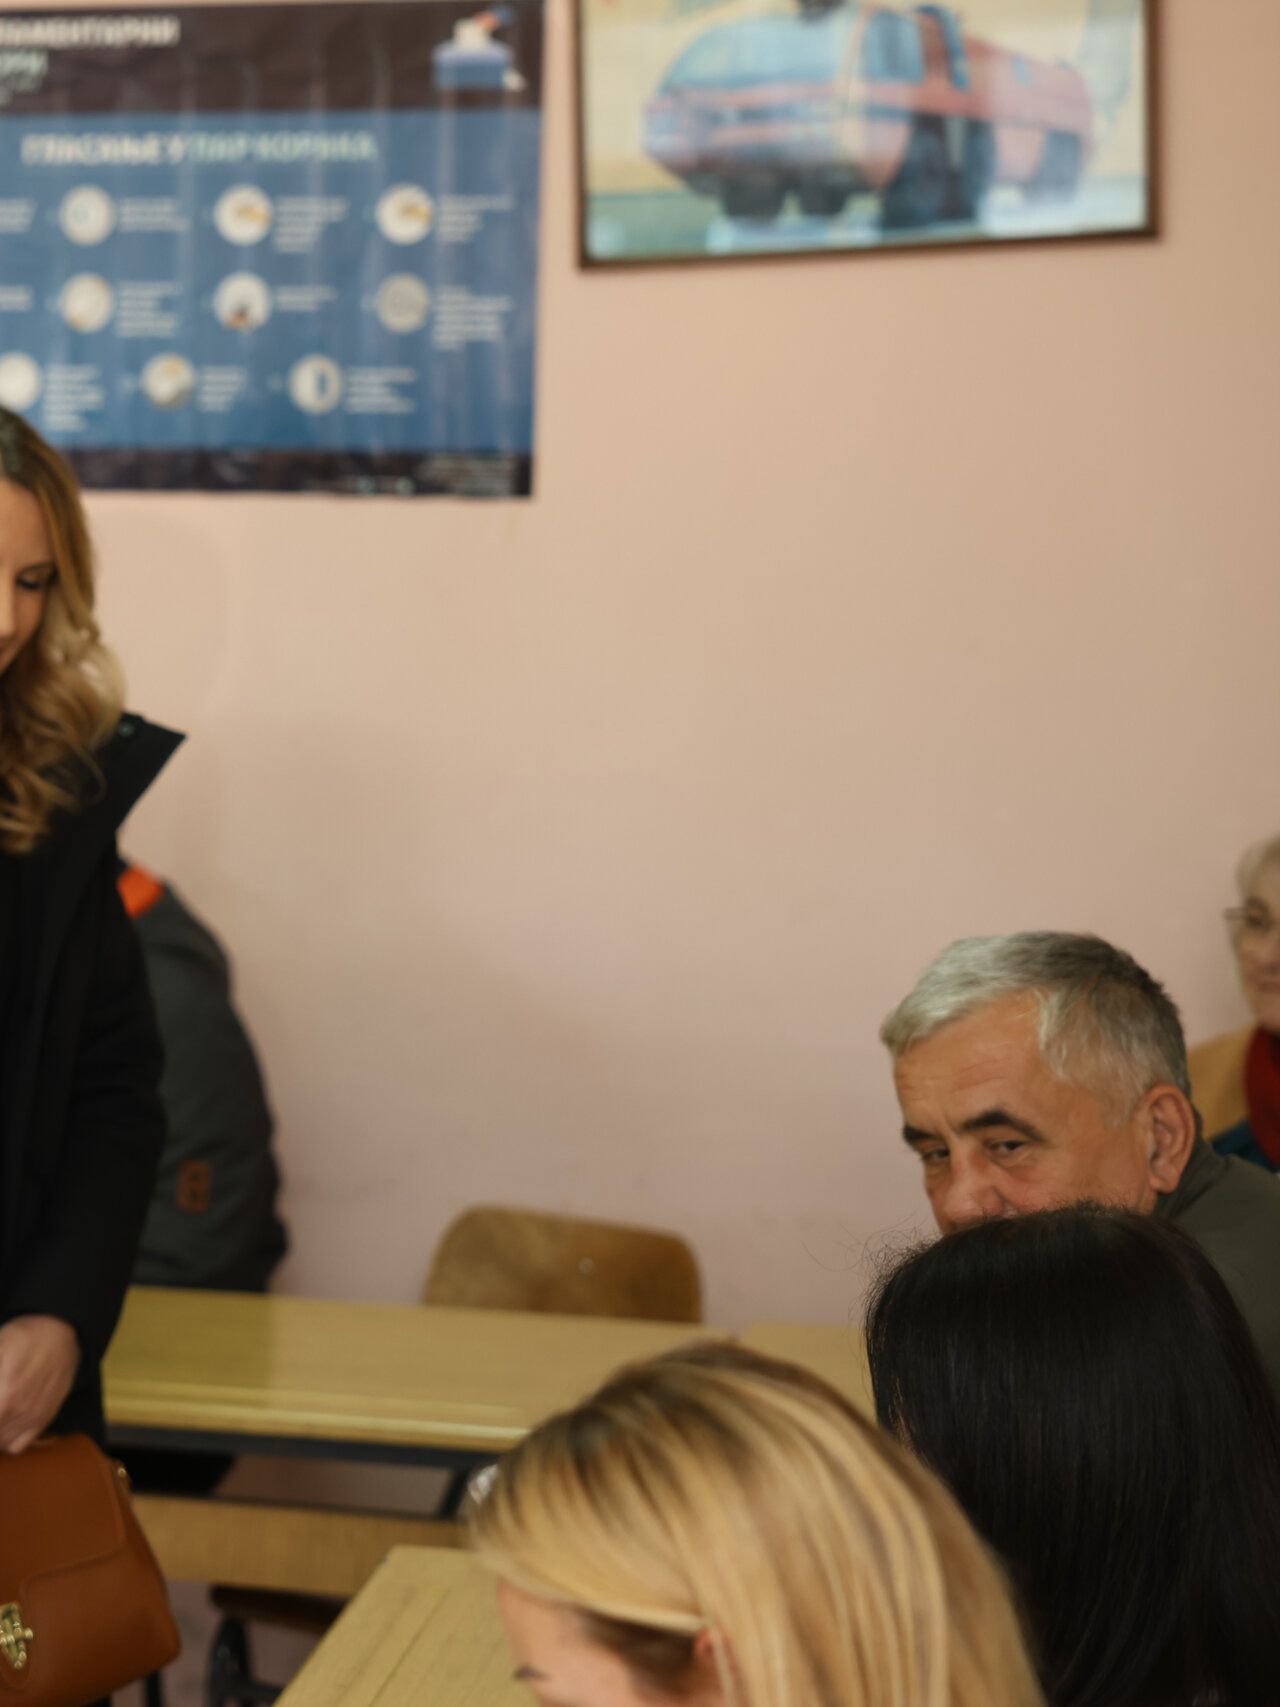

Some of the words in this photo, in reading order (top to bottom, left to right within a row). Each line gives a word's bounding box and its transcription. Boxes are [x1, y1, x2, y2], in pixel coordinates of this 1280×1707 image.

[22, 133, 160, 165] ГЛАСАЊЕ
[165, 133, 185, 164] У
[190, 131, 251, 162] ПАР
[255, 131, 376, 162] КОРАКА
